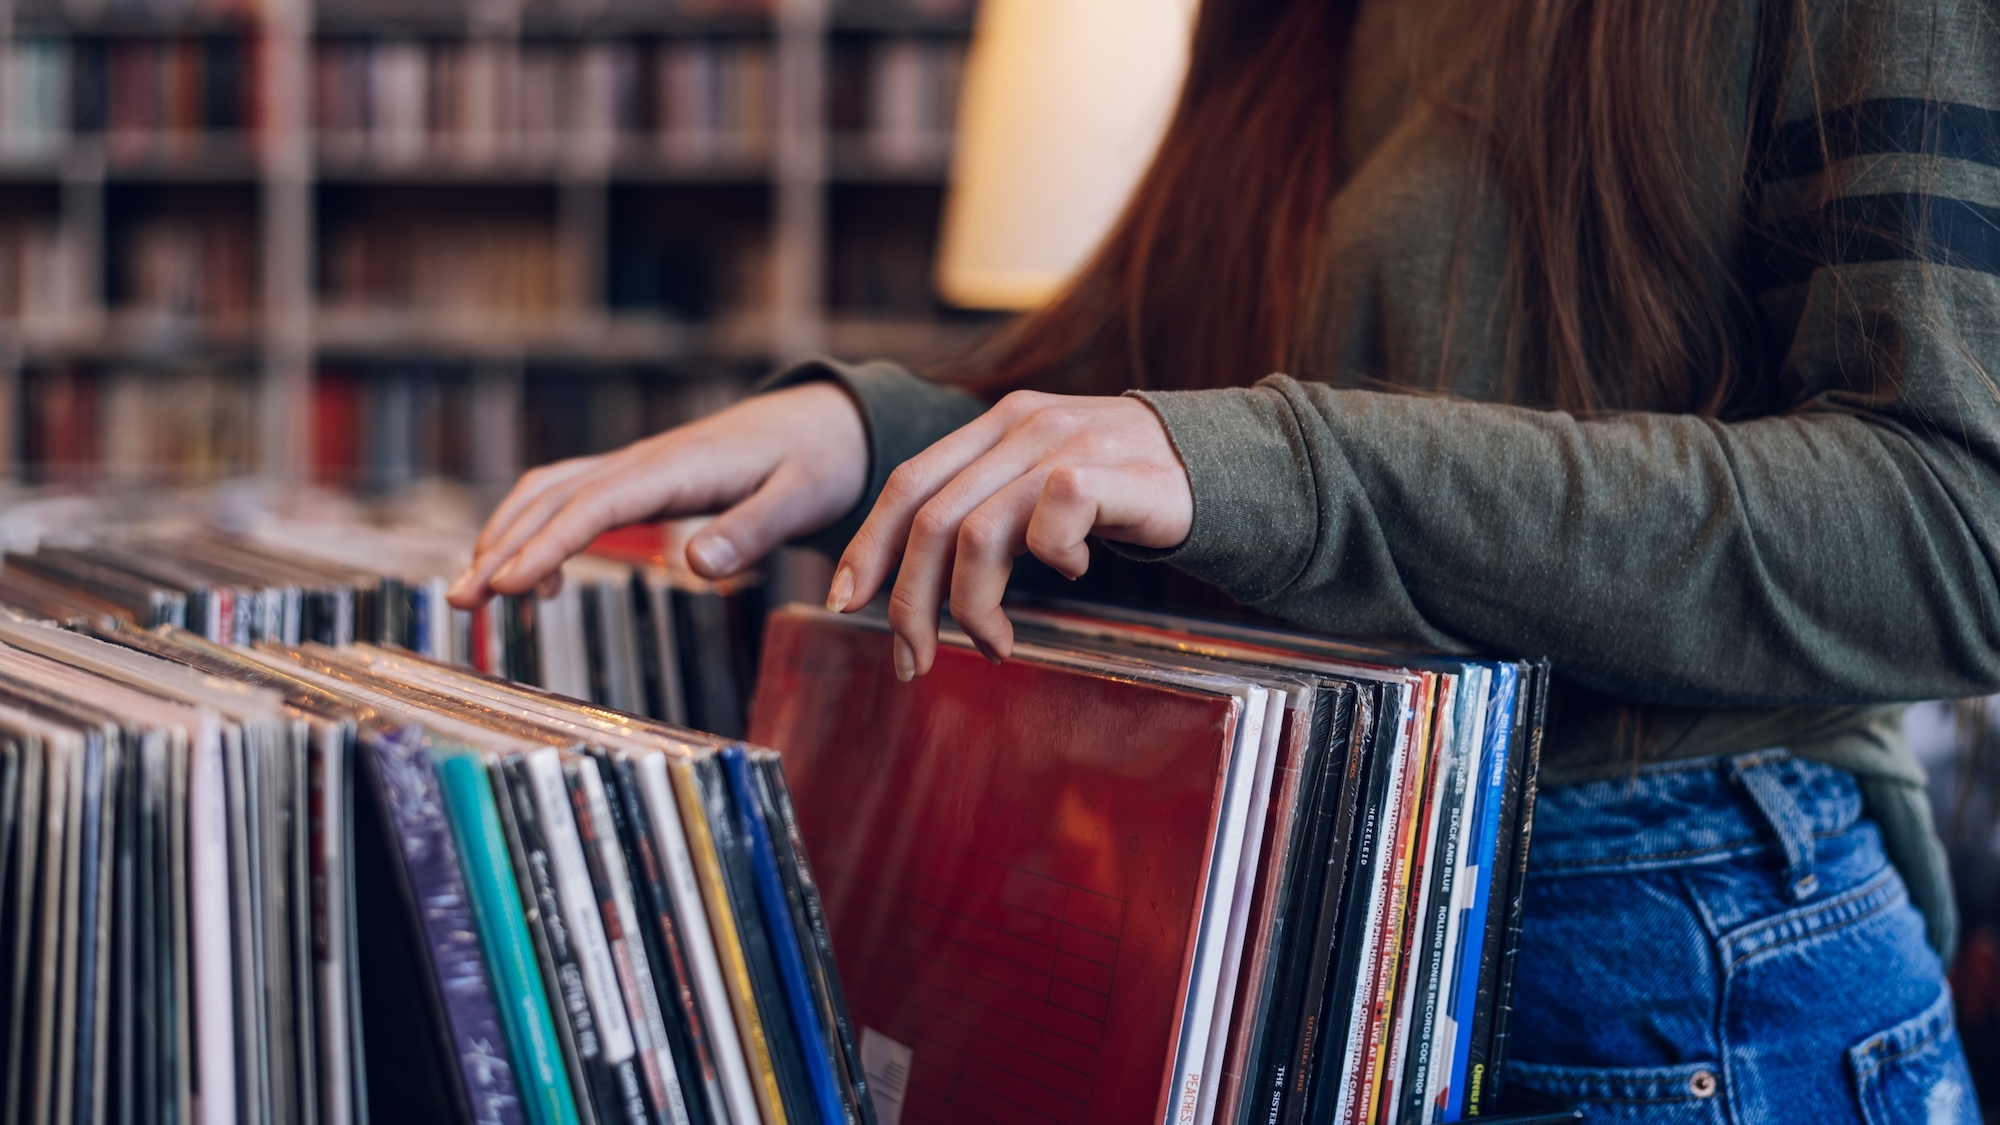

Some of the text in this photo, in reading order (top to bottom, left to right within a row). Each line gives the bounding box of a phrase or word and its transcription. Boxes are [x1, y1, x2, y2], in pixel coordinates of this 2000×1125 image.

[1496, 713, 1510, 750] ROLLING
[1348, 745, 1360, 778] RECORDS
[1395, 734, 1410, 788] MSTISLAV
[1454, 755, 1468, 794] STONES
[1492, 752, 1504, 787] STONES
[1360, 807, 1376, 866] HERZELEID
[1382, 789, 1402, 872] ROSTROPOVICH
[1449, 807, 1460, 840] BLACK
[1445, 842, 1455, 865] AND
[1392, 858, 1404, 886] RAGE
[1413, 865, 1424, 894] RAGE
[1441, 867, 1452, 892] BLUE
[1374, 879, 1389, 925] LONDON
[1386, 888, 1400, 931] AGAINST
[1398, 885, 1406, 906] RAGE
[1394, 907, 1404, 940] AGAINST
[1434, 905, 1447, 949] ROLLING
[1383, 932, 1394, 953] THE
[1362, 926, 1382, 1006] PHILHARMONIC
[1376, 955, 1390, 1003] MACHINE
[1386, 958, 1396, 992] MACHINE
[1428, 950, 1441, 990] STONES
[1355, 984, 1364, 1005] ROD
[1382, 999, 1390, 1016] EVIL
[1348, 1009, 1362, 1054] STEWART
[1370, 1021, 1381, 1044] LIVE
[1379, 1018, 1388, 1046] EMPIRE
[1422, 992, 1436, 1040] RECORDS
[1296, 1015, 1315, 1093] SEPULTURA ARISE
[1351, 1007, 1370, 1072] ORCHESTRA
[1368, 1046, 1377, 1059] AT
[1387, 1018, 1402, 1080] RENEGADES
[1419, 1042, 1429, 1063] COC
[1275, 1066, 1286, 1087] THE
[1342, 1072, 1350, 1092] THE
[1364, 1060, 1375, 1081] THE
[1415, 1066, 1426, 1094] 59106
[1345, 1080, 1358, 1118] CARLO
[1360, 1083, 1372, 1119] GRAND
[1468, 1064, 1485, 1115] Queens of
